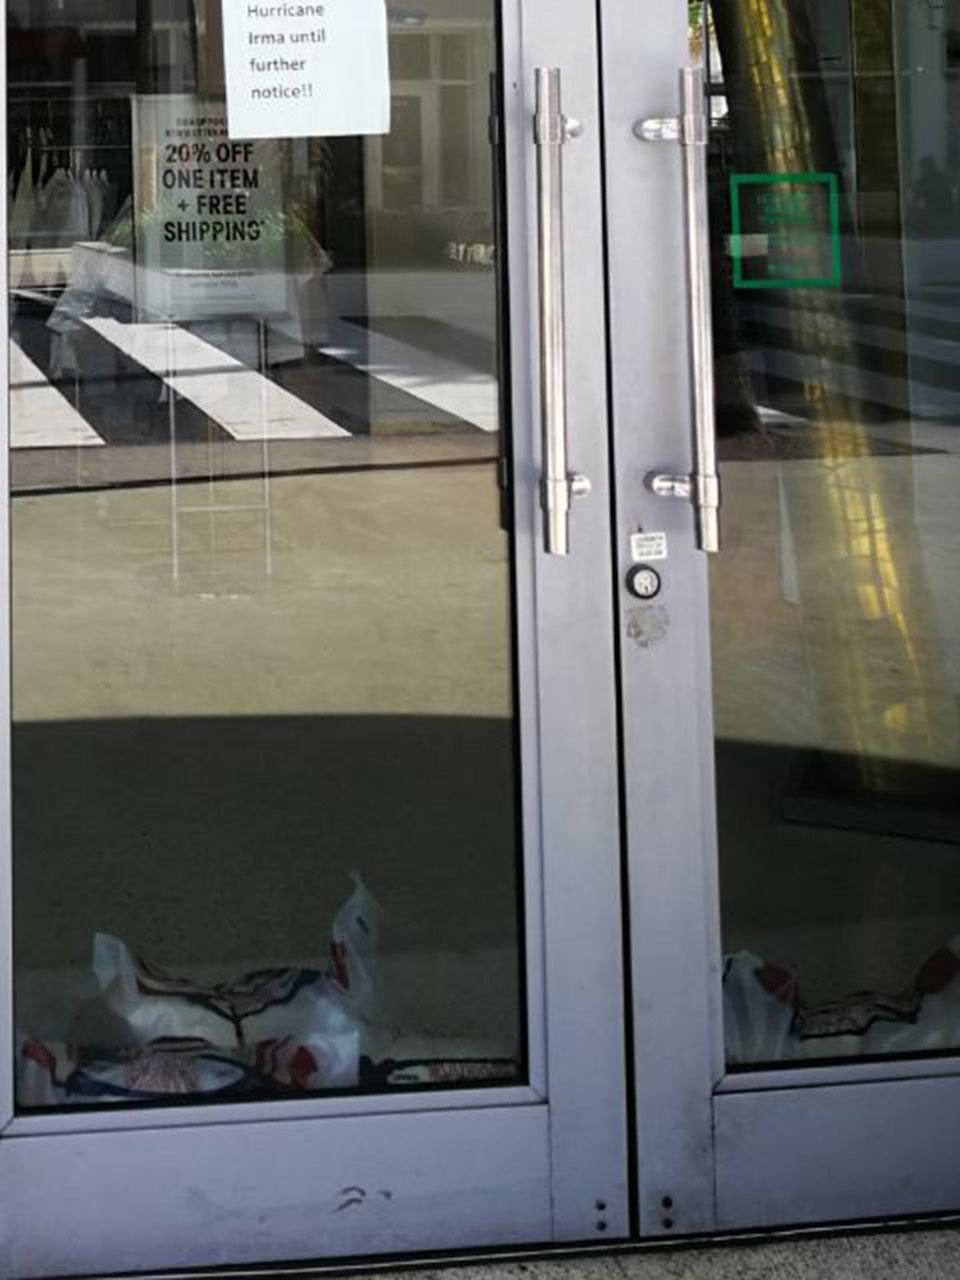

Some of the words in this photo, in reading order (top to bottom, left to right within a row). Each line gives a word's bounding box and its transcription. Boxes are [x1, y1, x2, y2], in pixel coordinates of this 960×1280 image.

[247, 2, 326, 18] Hurricane
[248, 31, 285, 45] Irma
[289, 28, 327, 44] until
[250, 57, 307, 73] further
[251, 83, 314, 100] notice!!
[165, 143, 212, 163] 20%
[216, 143, 254, 162] OFF
[162, 169, 203, 189] ONE
[209, 169, 259, 189] ITEM
[197, 195, 247, 214] FREE
